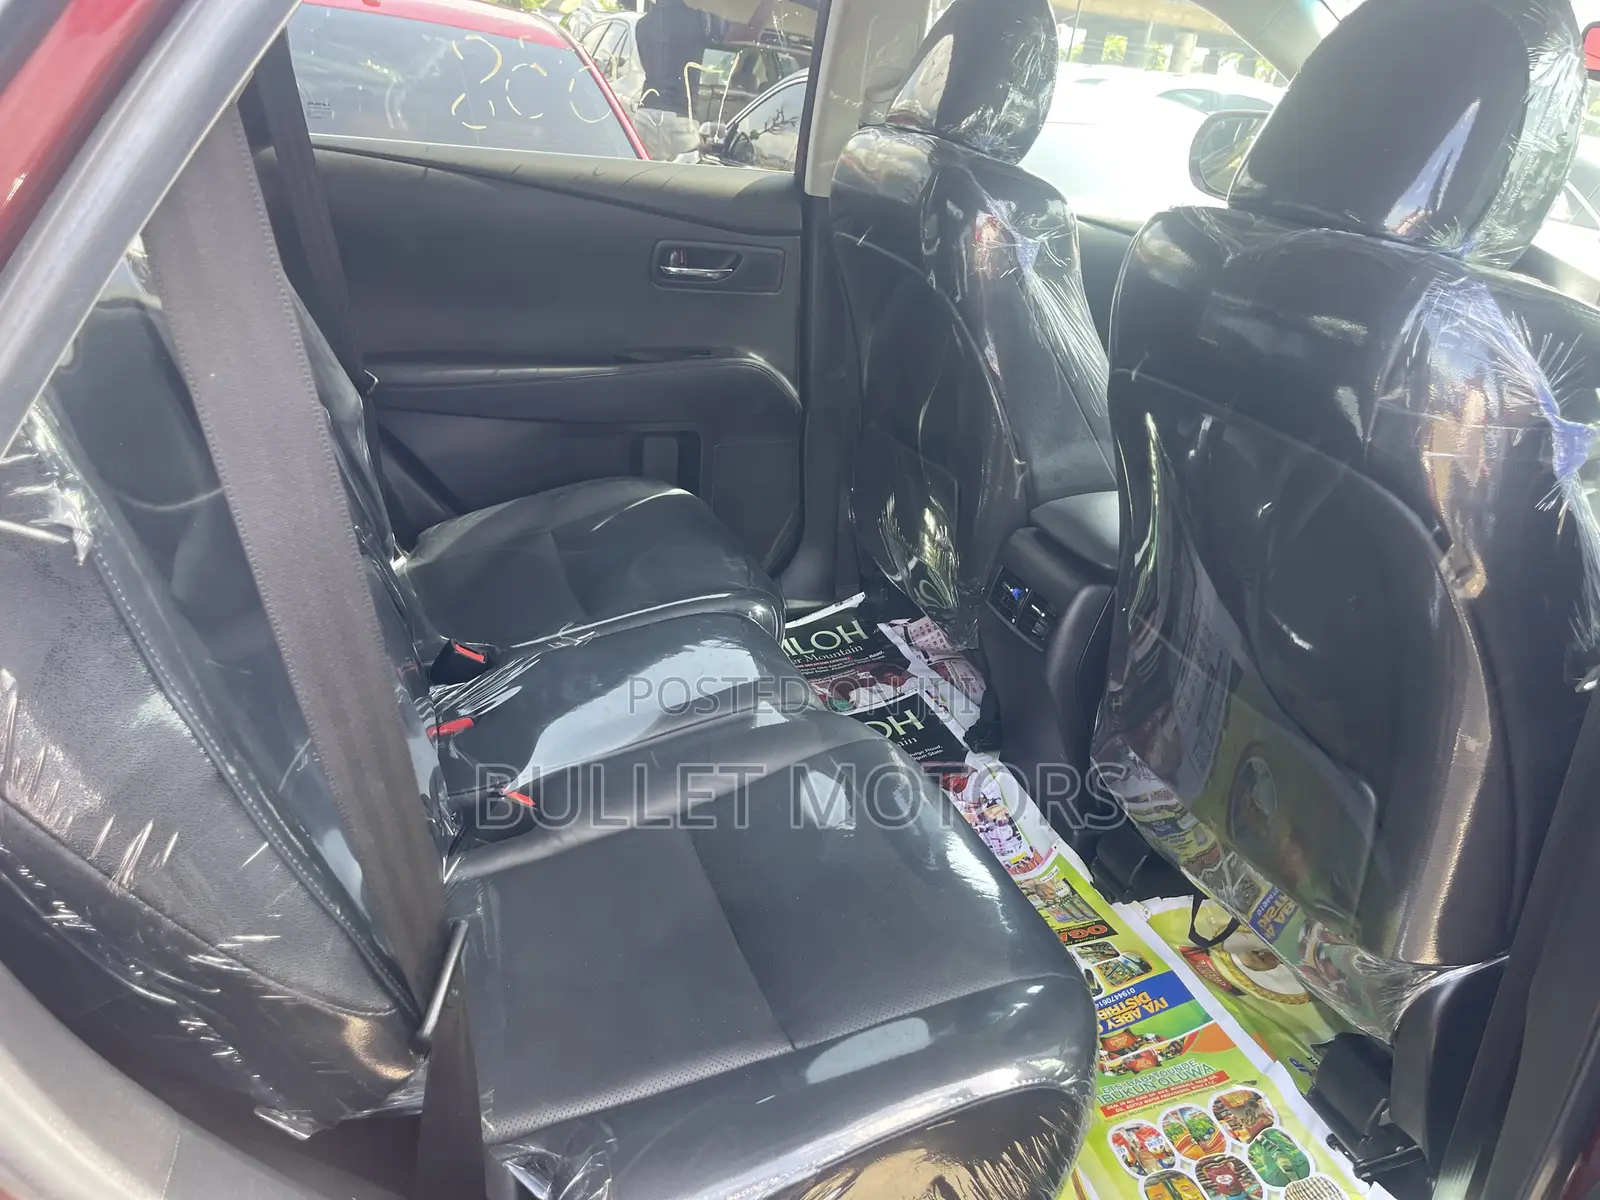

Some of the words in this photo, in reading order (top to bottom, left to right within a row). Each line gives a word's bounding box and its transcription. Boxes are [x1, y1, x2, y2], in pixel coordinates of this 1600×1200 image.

[804, 645, 864, 662] Mountain
[1142, 996, 1169, 1014] IYA
[1106, 1008, 1142, 1031] ABEY
[1096, 1080, 1157, 1104] IBUKUN
[1158, 1063, 1215, 1087] OLUWA
[1130, 1058, 1198, 1087] BABATOUNDE
